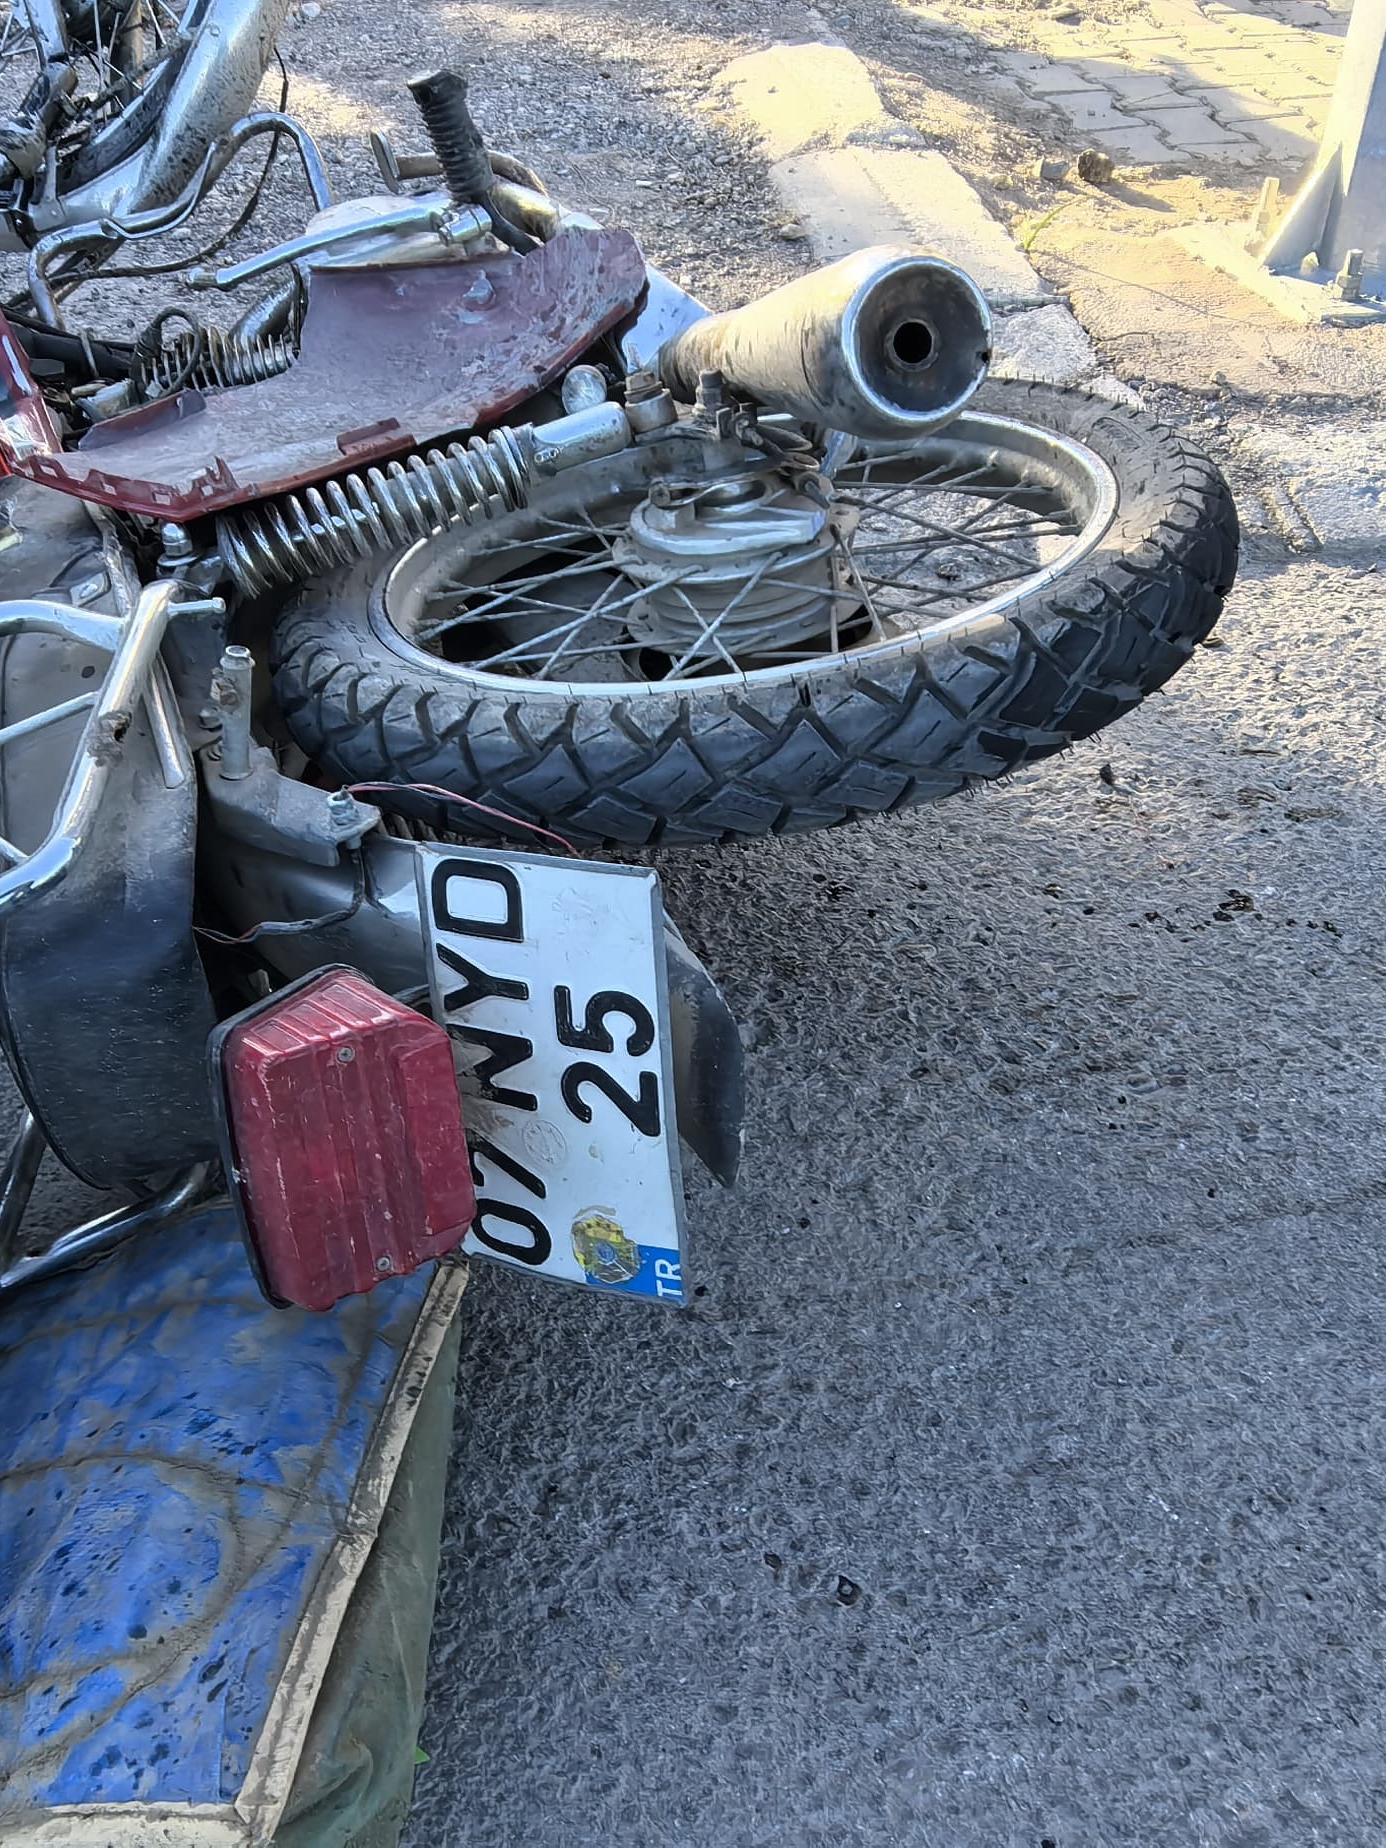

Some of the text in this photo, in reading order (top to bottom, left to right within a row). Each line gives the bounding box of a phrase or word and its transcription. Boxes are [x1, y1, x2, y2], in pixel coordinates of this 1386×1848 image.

[431, 858, 538, 1112] NYD
[554, 985, 660, 1137] 25
[466, 1128, 552, 1266] 07
[655, 1259, 682, 1297] TR
